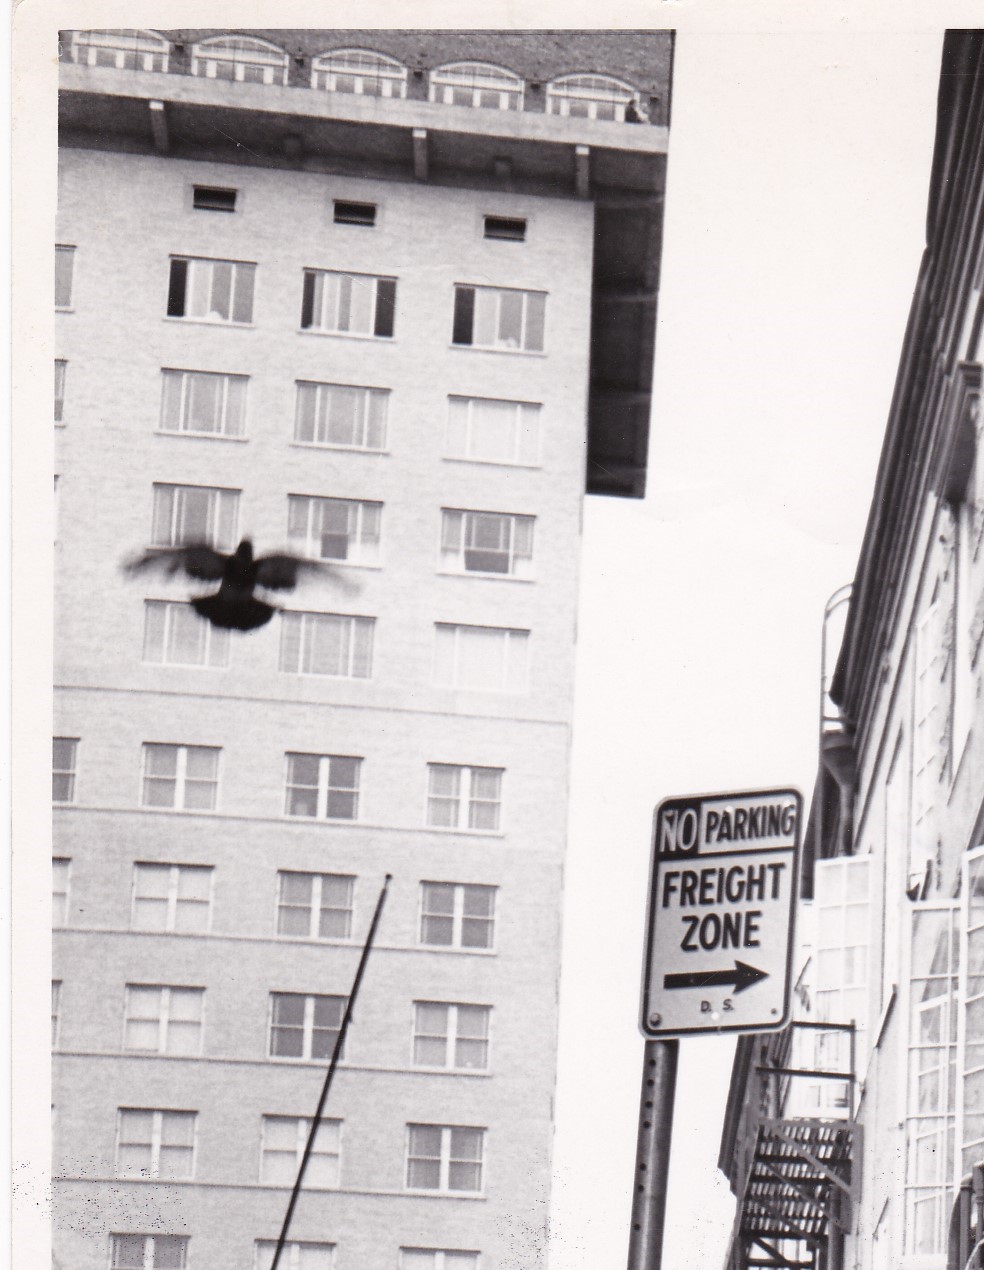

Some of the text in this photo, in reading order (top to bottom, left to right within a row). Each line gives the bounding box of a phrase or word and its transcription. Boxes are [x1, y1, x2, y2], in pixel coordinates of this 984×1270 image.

[659, 804, 796, 852] NO PARKING
[662, 862, 786, 908] FREIGHT
[680, 910, 763, 952] ZONE
